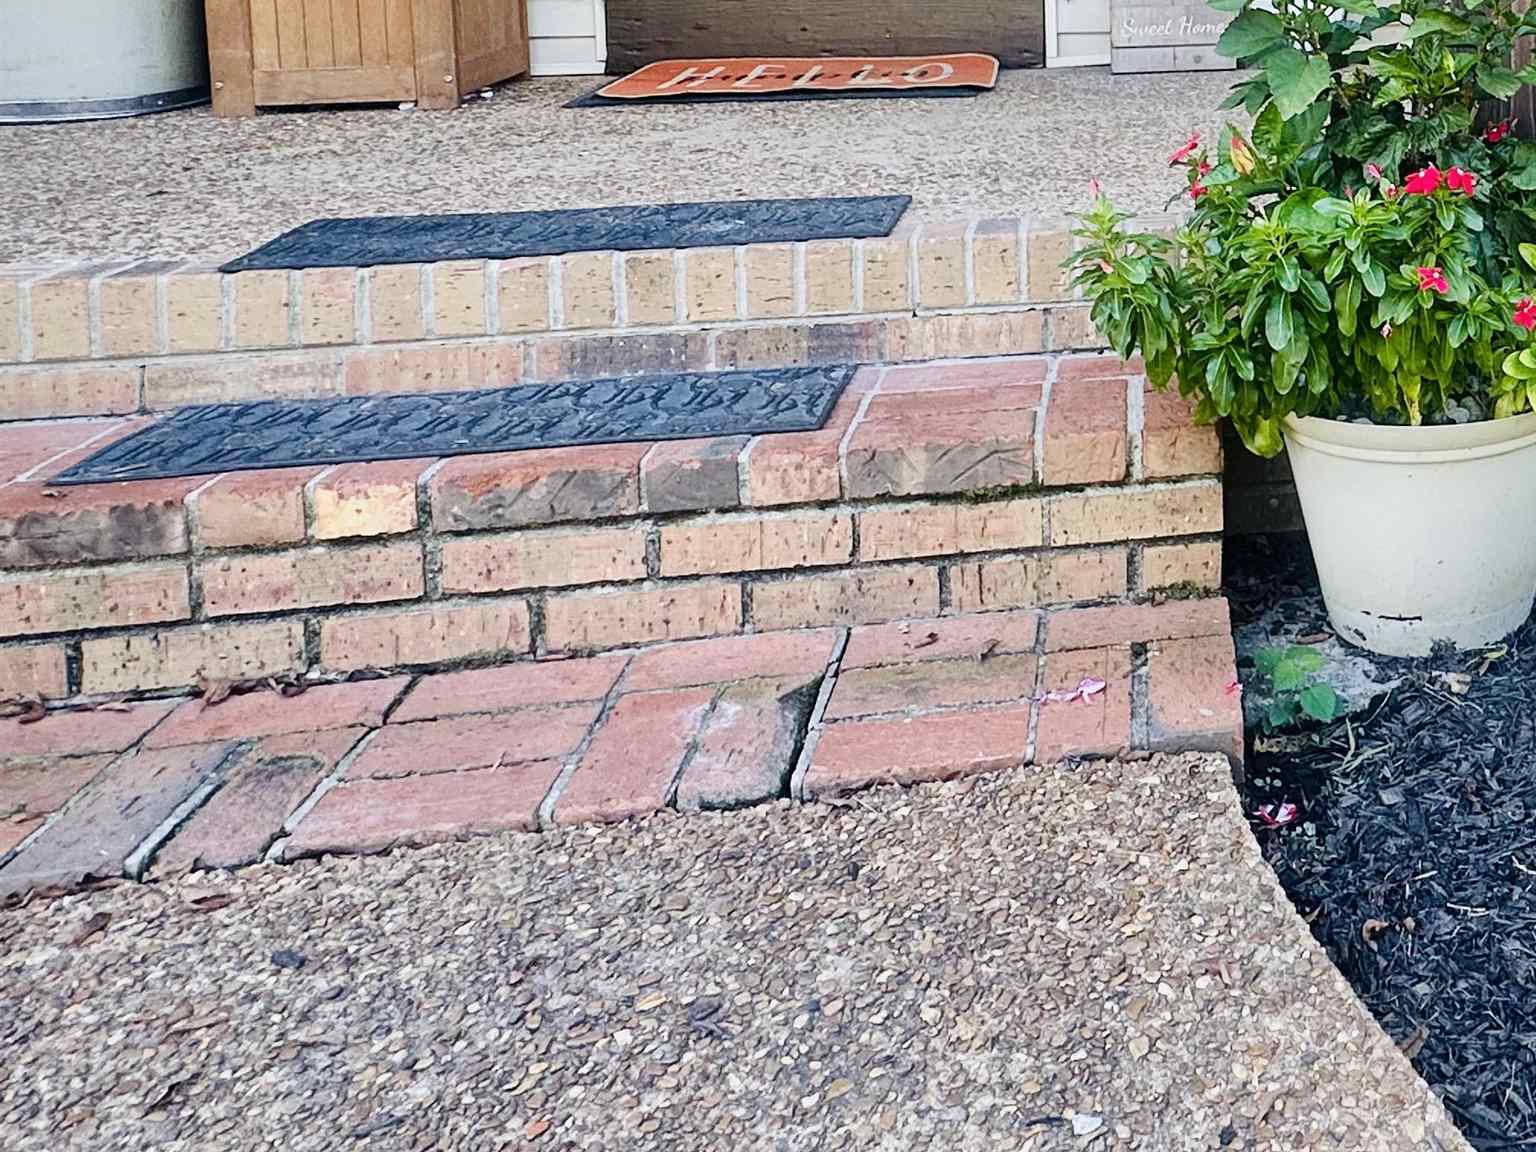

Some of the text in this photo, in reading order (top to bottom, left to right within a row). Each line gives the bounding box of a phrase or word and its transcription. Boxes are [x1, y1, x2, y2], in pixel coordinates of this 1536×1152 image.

[1123, 15, 1225, 38] Sweet Home
[656, 62, 955, 90] HELLO
